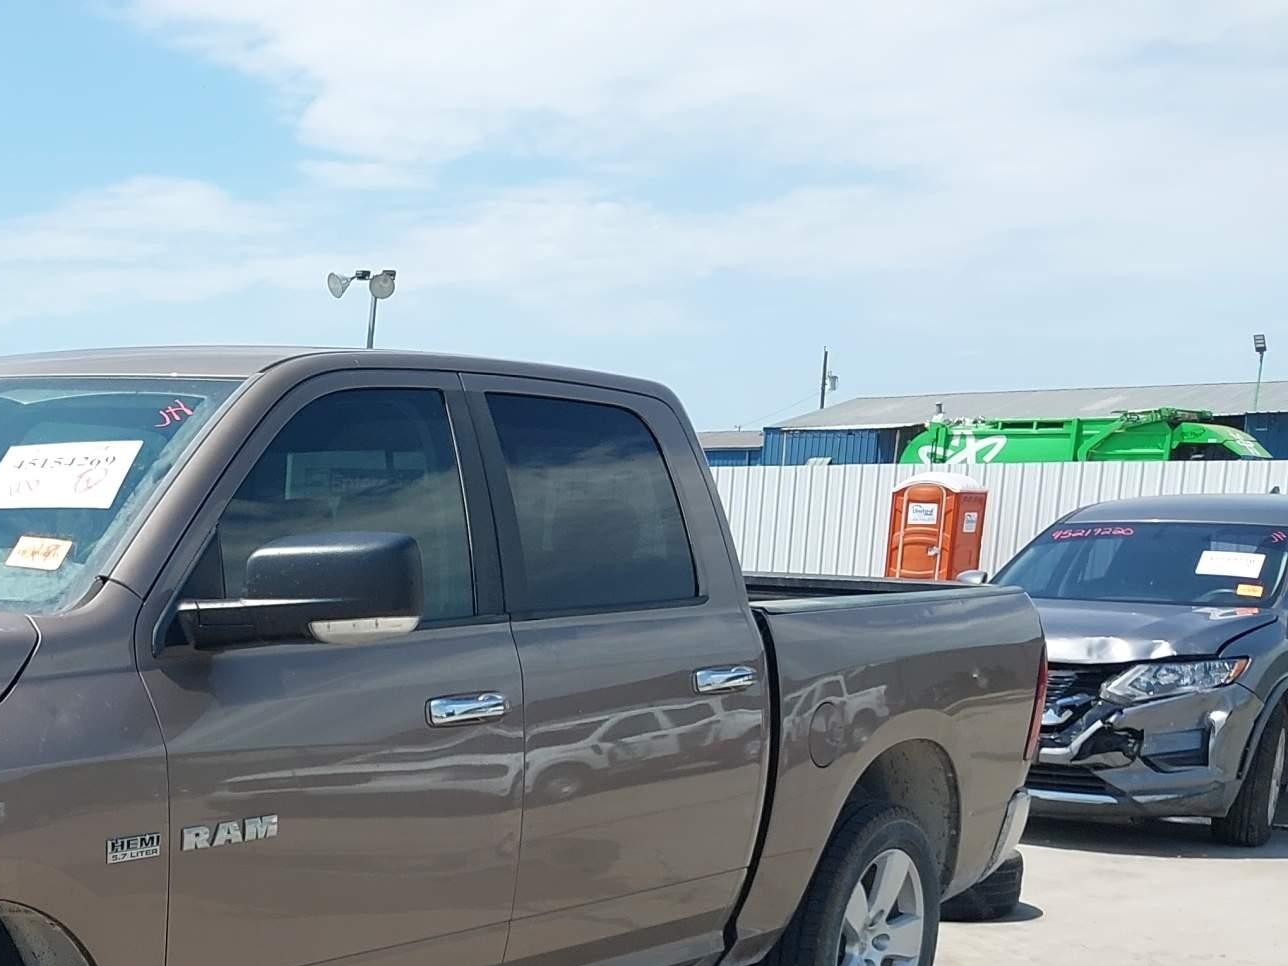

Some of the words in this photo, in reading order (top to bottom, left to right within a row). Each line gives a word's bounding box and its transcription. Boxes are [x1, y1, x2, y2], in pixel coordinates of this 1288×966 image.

[181, 814, 278, 851] RAM
[111, 835, 160, 853] HEMI
[112, 853, 128, 862] 5.7
[129, 848, 159, 858] LITER
